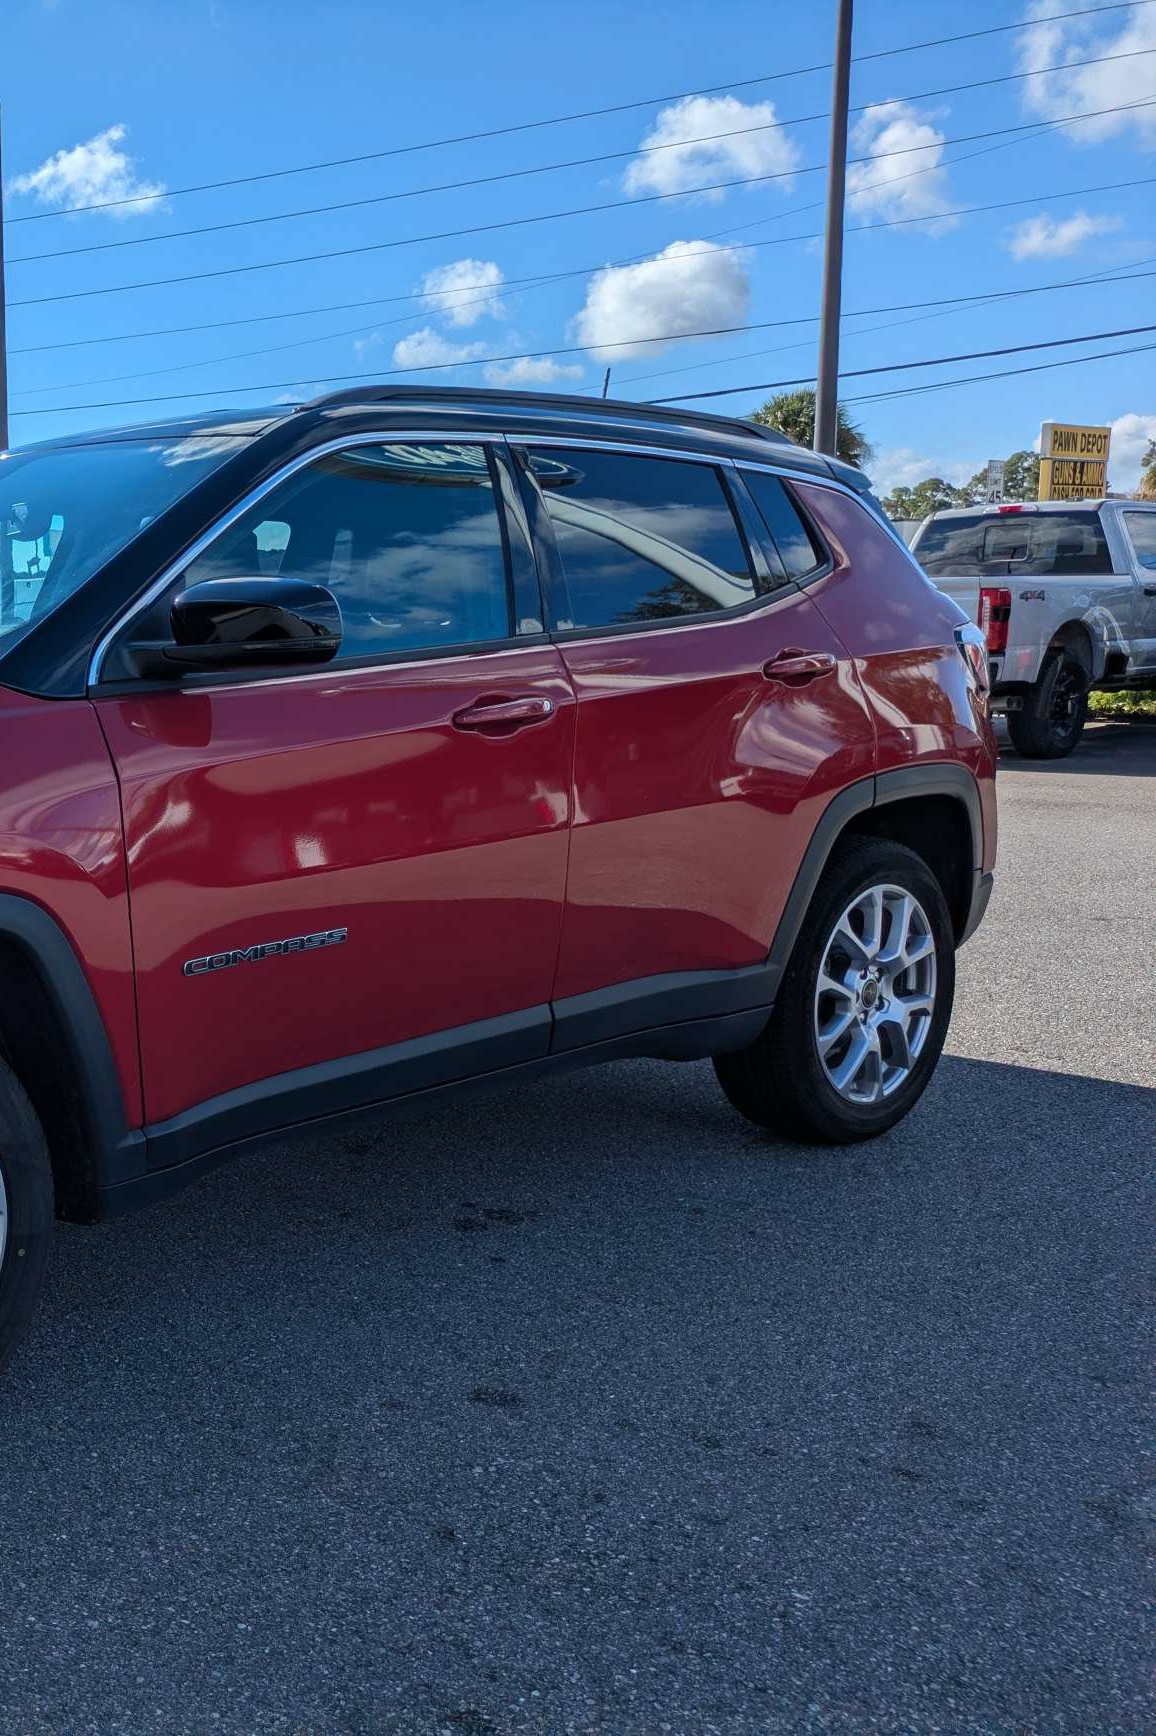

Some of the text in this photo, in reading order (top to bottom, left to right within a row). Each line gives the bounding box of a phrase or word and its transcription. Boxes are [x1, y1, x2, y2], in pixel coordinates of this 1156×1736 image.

[1052, 430, 1108, 455] PAWN DEPOT
[1053, 461, 1103, 486] GUNS & AMMO
[183, 928, 347, 976] COMPASS
